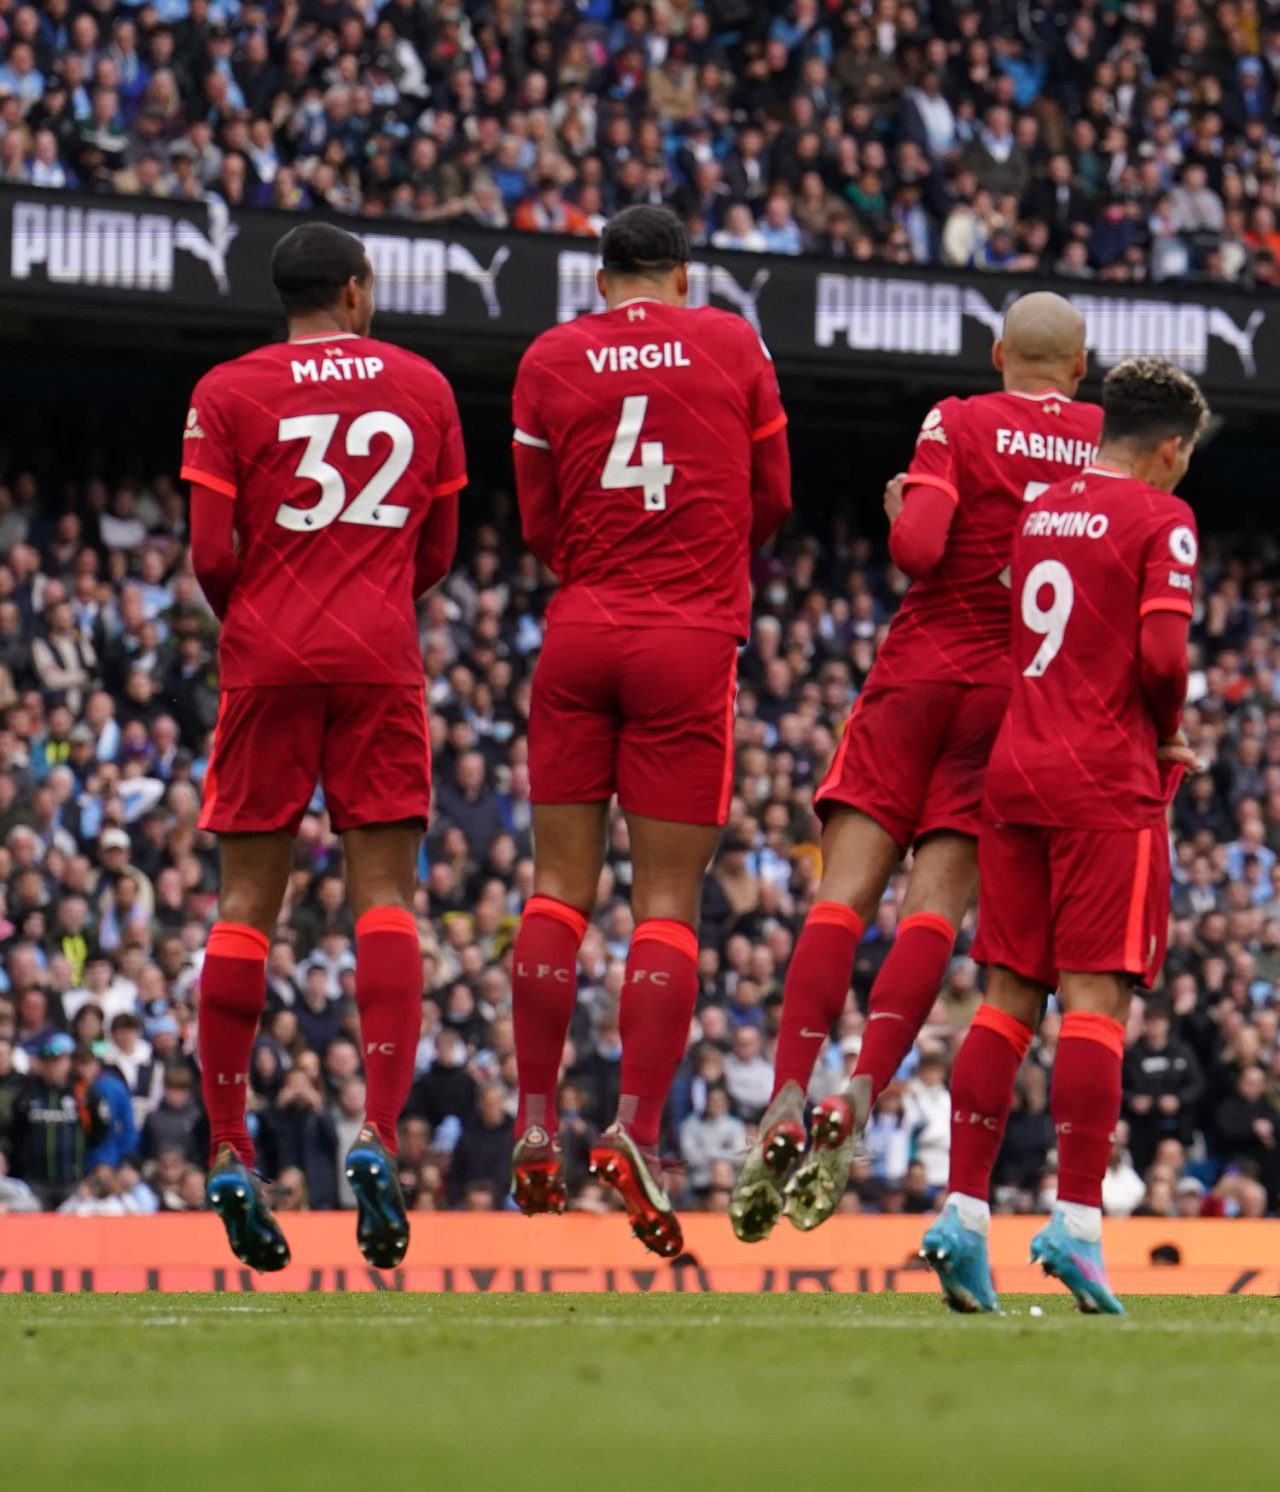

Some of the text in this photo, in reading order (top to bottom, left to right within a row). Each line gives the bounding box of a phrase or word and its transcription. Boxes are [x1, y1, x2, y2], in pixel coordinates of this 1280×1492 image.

[11, 201, 174, 292] PUMA
[359, 233, 447, 316] MA
[814, 272, 962, 356] PUMA
[290, 356, 384, 384] MATIP
[585, 341, 691, 373] VIRGIL
[275, 410, 414, 532] 32
[601, 395, 675, 511] 4
[1022, 510, 1109, 539] FIRMINO
[1021, 559, 1074, 677] 9
